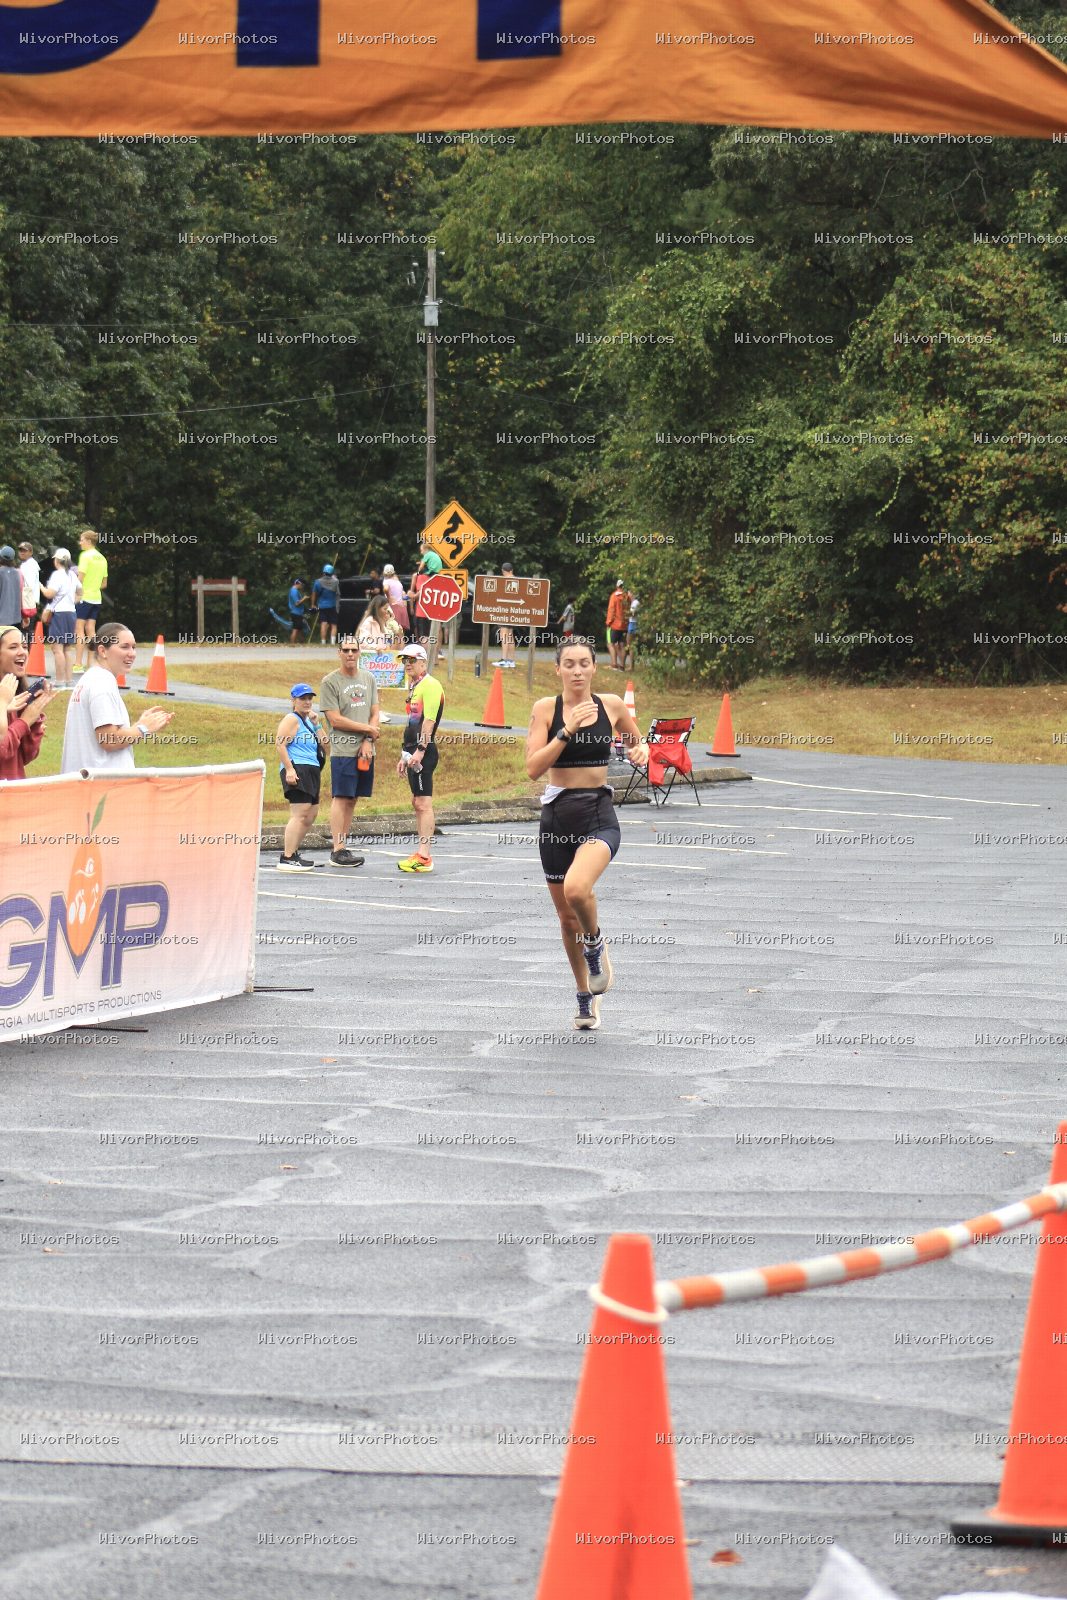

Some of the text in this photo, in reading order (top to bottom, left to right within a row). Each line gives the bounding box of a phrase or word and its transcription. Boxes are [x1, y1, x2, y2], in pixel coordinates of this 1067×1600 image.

[443, 573, 465, 587] 5
[422, 587, 460, 609] STOP
[476, 604, 509, 613] Muscadine
[510, 606, 530, 614] Nature
[489, 614, 530, 624] Tennis Courts
[375, 655, 389, 663] GO
[0, 880, 170, 1010] GMP
[27, 1001, 95, 1024] MULTISPORTS
[98, 989, 162, 1010] PRODUCTIONS
